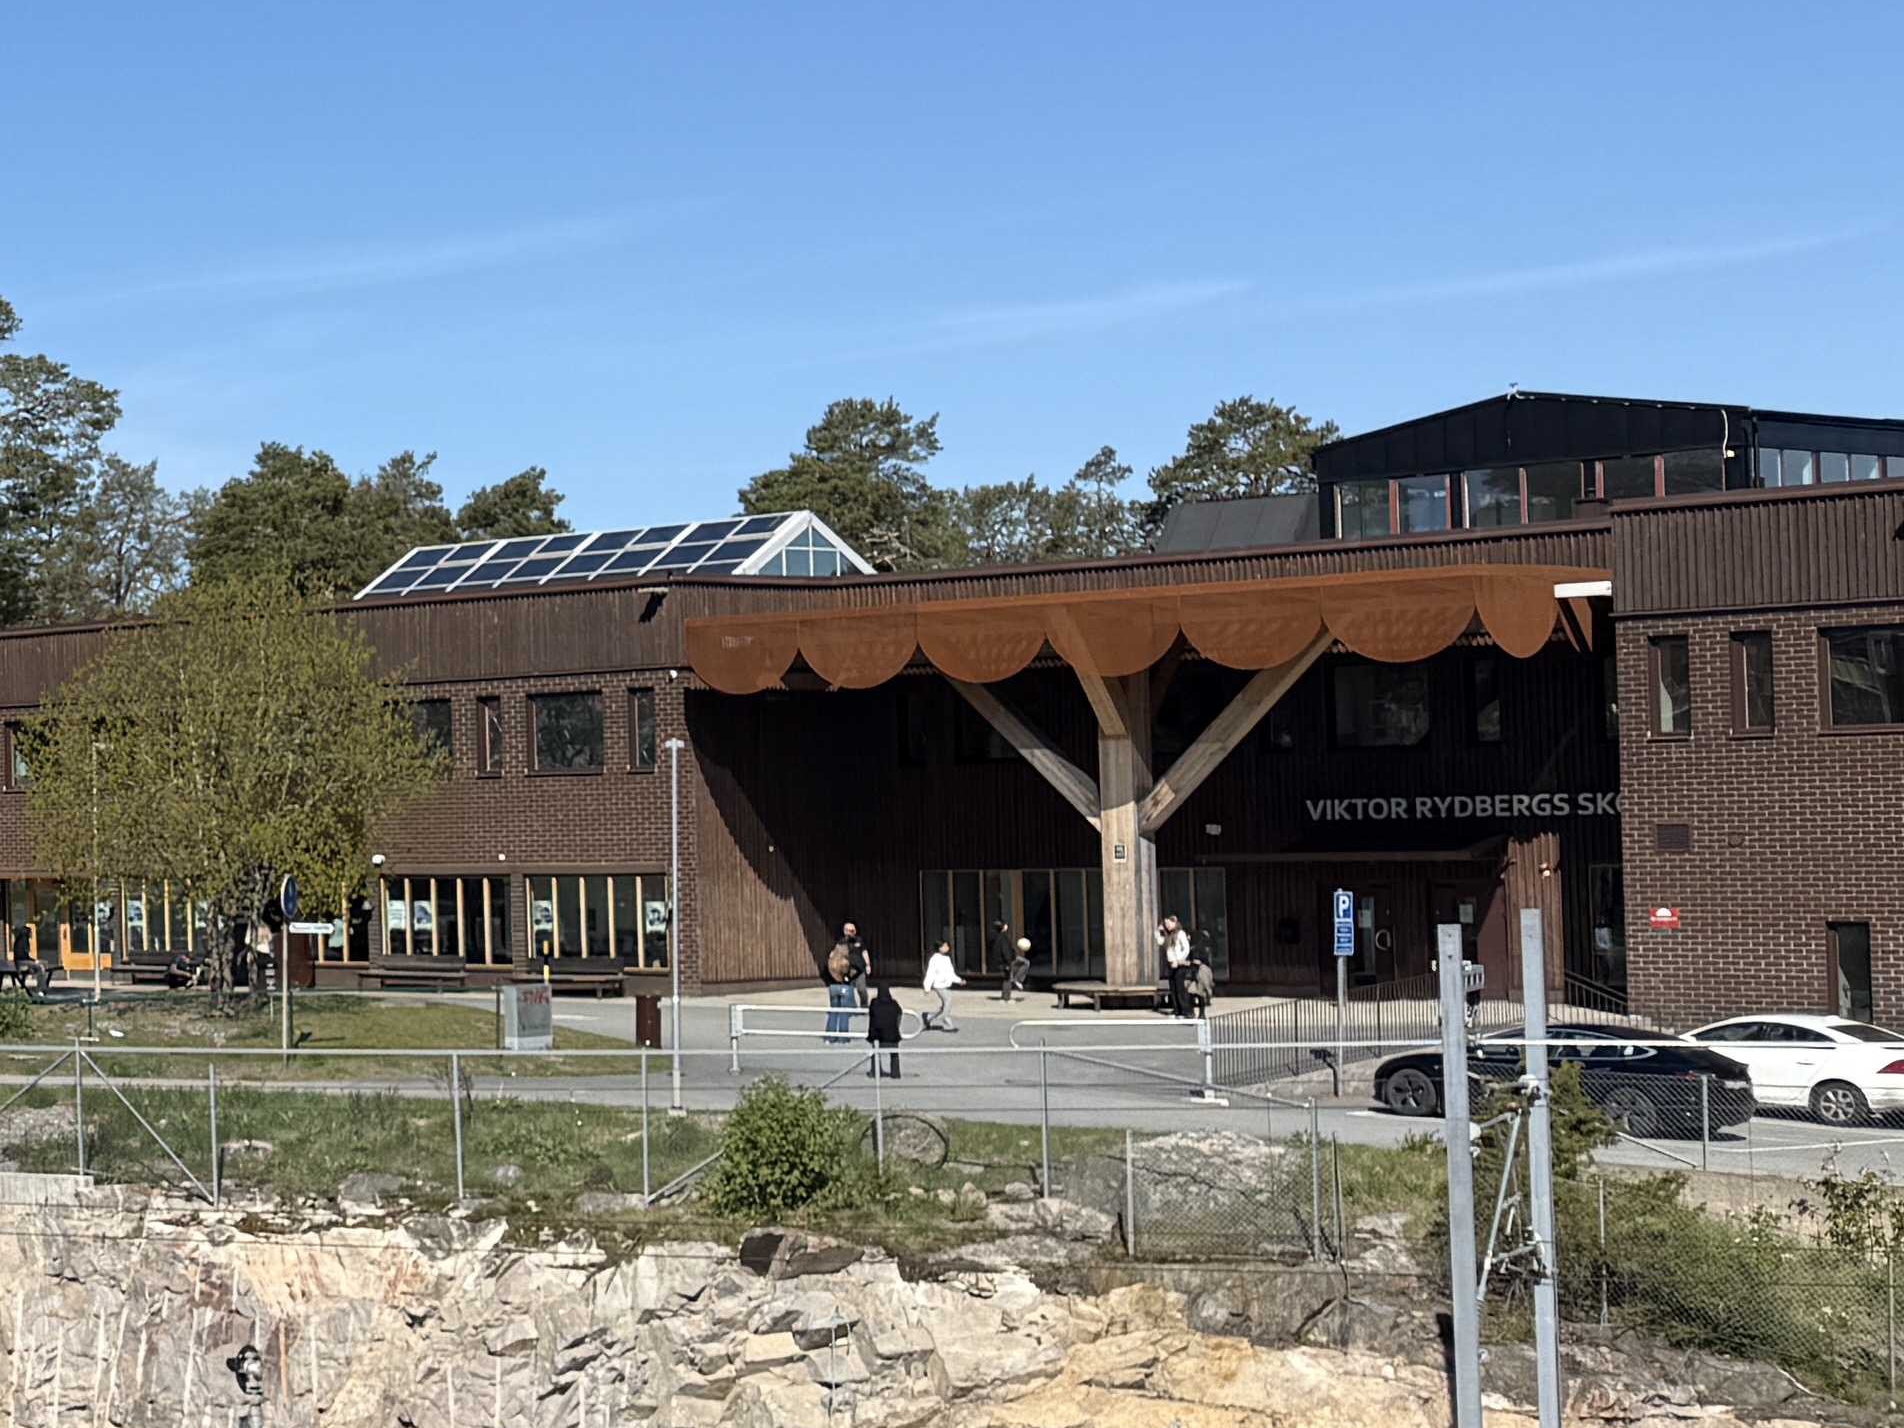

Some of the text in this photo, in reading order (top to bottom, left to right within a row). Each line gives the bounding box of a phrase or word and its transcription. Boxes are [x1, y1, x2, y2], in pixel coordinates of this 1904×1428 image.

[1306, 797, 1408, 821] VIKTOR
[1415, 793, 1570, 819] RYDBERGS
[1338, 895, 1350, 918] P
